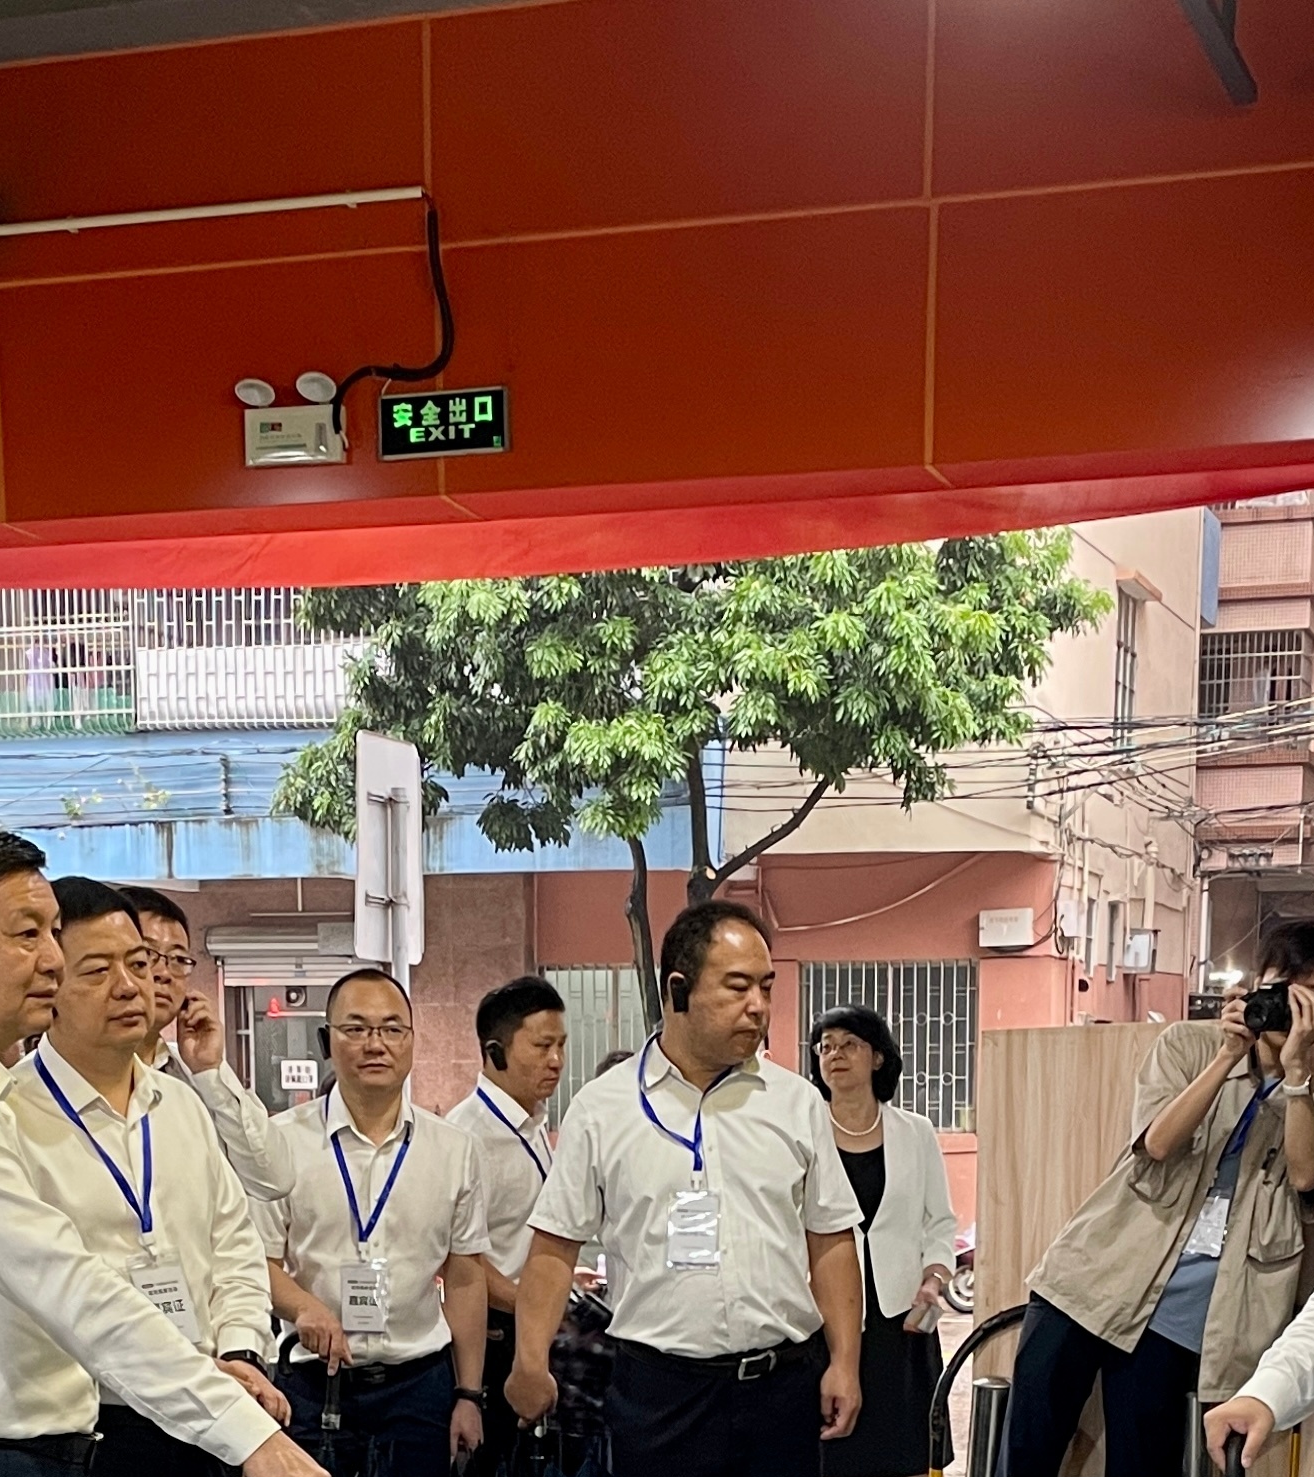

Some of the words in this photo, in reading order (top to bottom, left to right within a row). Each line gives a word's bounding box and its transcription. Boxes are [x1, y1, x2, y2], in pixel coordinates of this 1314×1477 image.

[392, 395, 493, 428] 安全出口
[409, 423, 476, 443] EXIT
